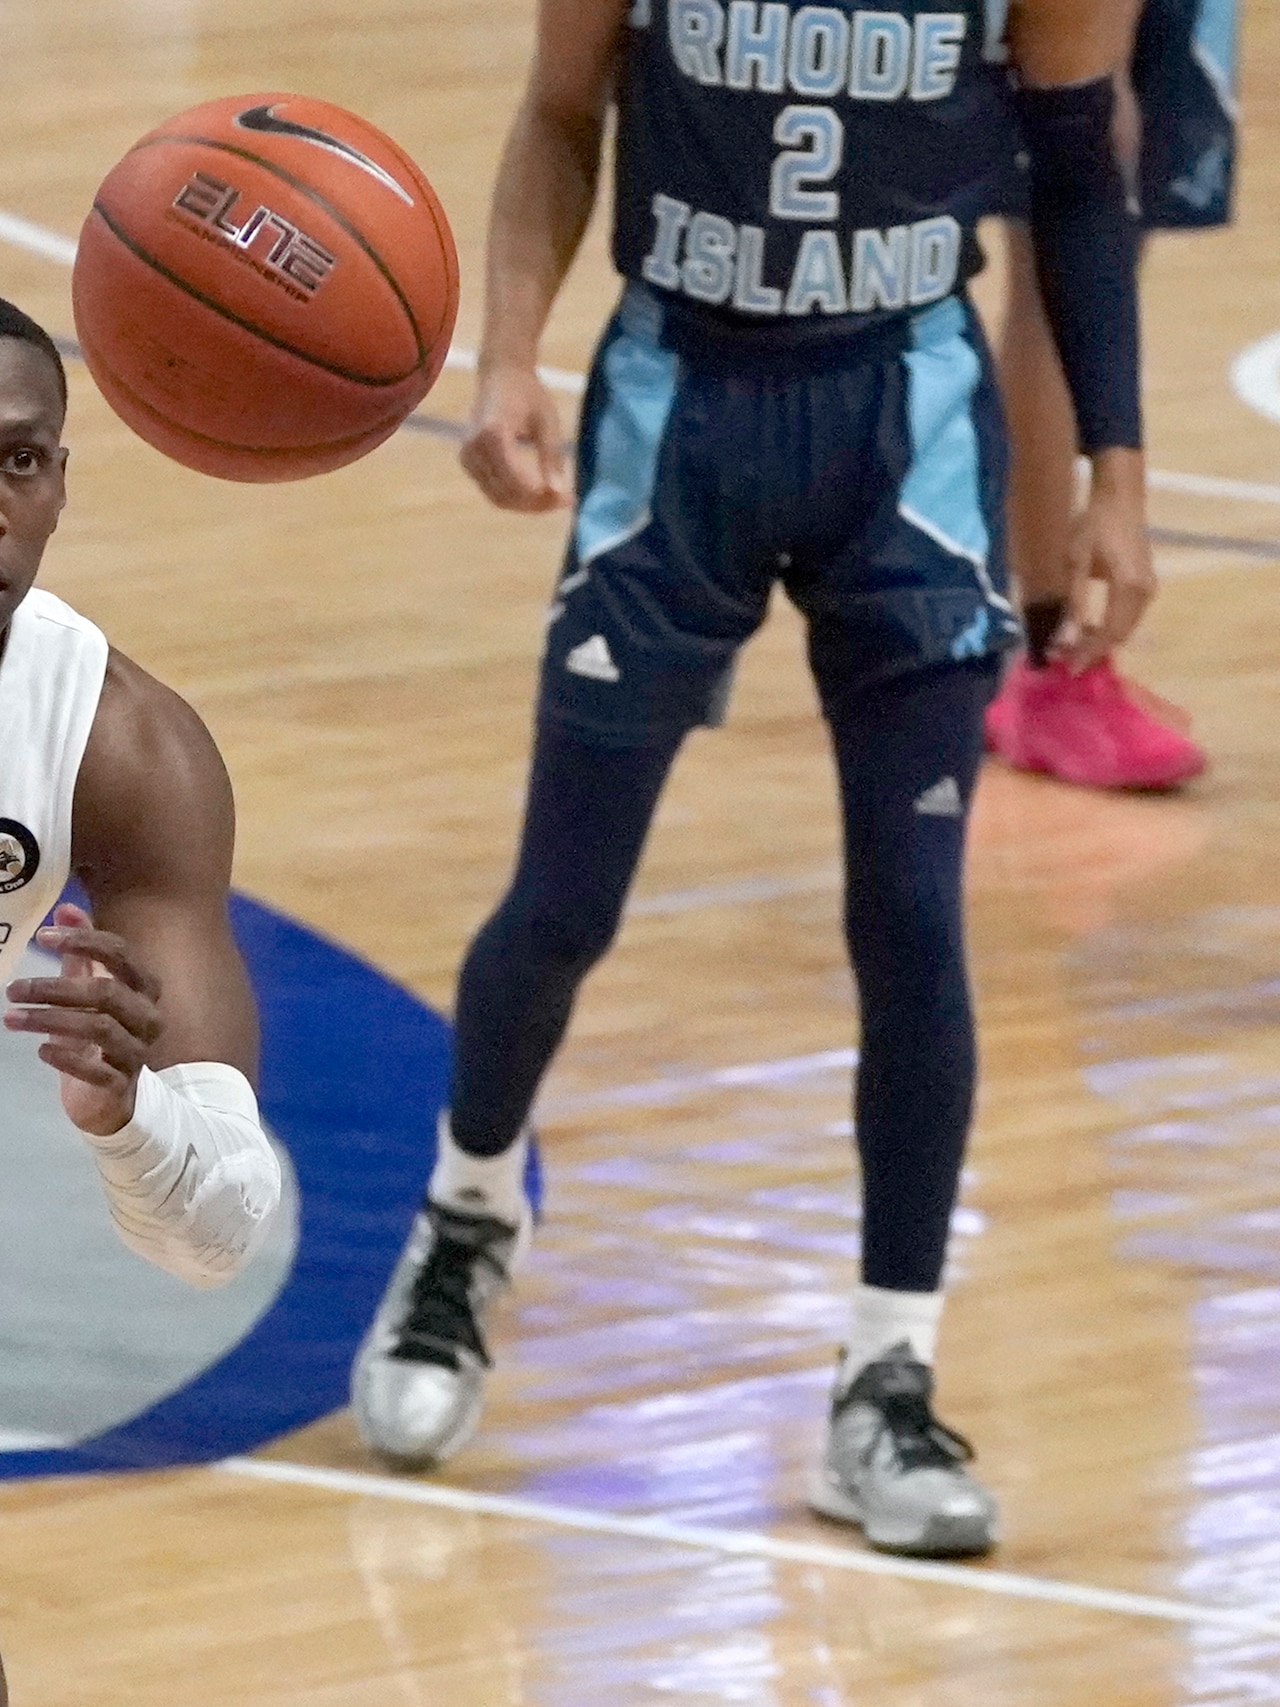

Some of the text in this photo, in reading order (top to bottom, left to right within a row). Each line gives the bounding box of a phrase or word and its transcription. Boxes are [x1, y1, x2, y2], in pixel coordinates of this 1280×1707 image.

[667, 0, 966, 100] RHODE
[769, 105, 844, 221] 2
[173, 172, 336, 297] ELITE
[642, 193, 962, 315] ISLAND
